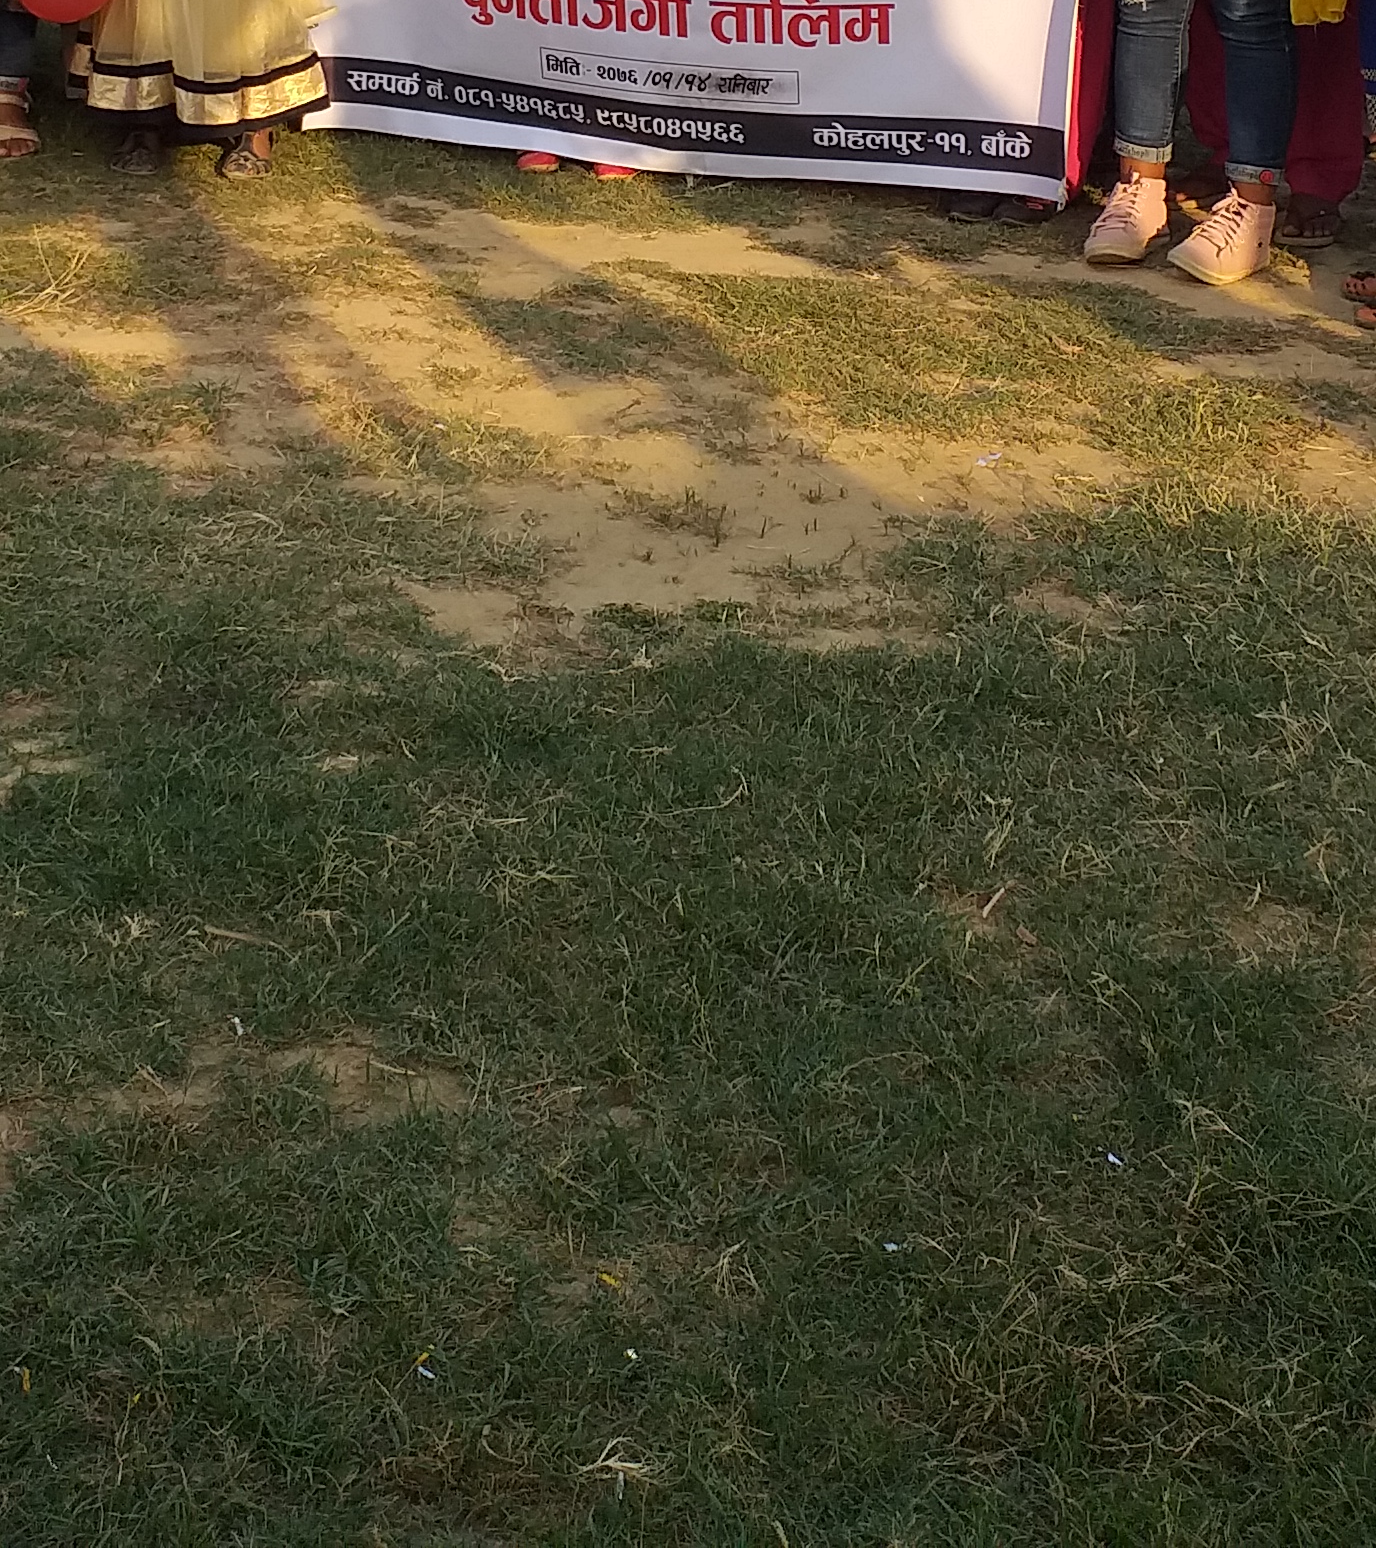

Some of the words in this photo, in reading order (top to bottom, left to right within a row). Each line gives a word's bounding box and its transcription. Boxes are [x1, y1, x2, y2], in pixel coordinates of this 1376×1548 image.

[346, 70, 421, 96] सम्पर्क
[426, 78, 449, 101] नं.
[980, 129, 1033, 159] बाँके
